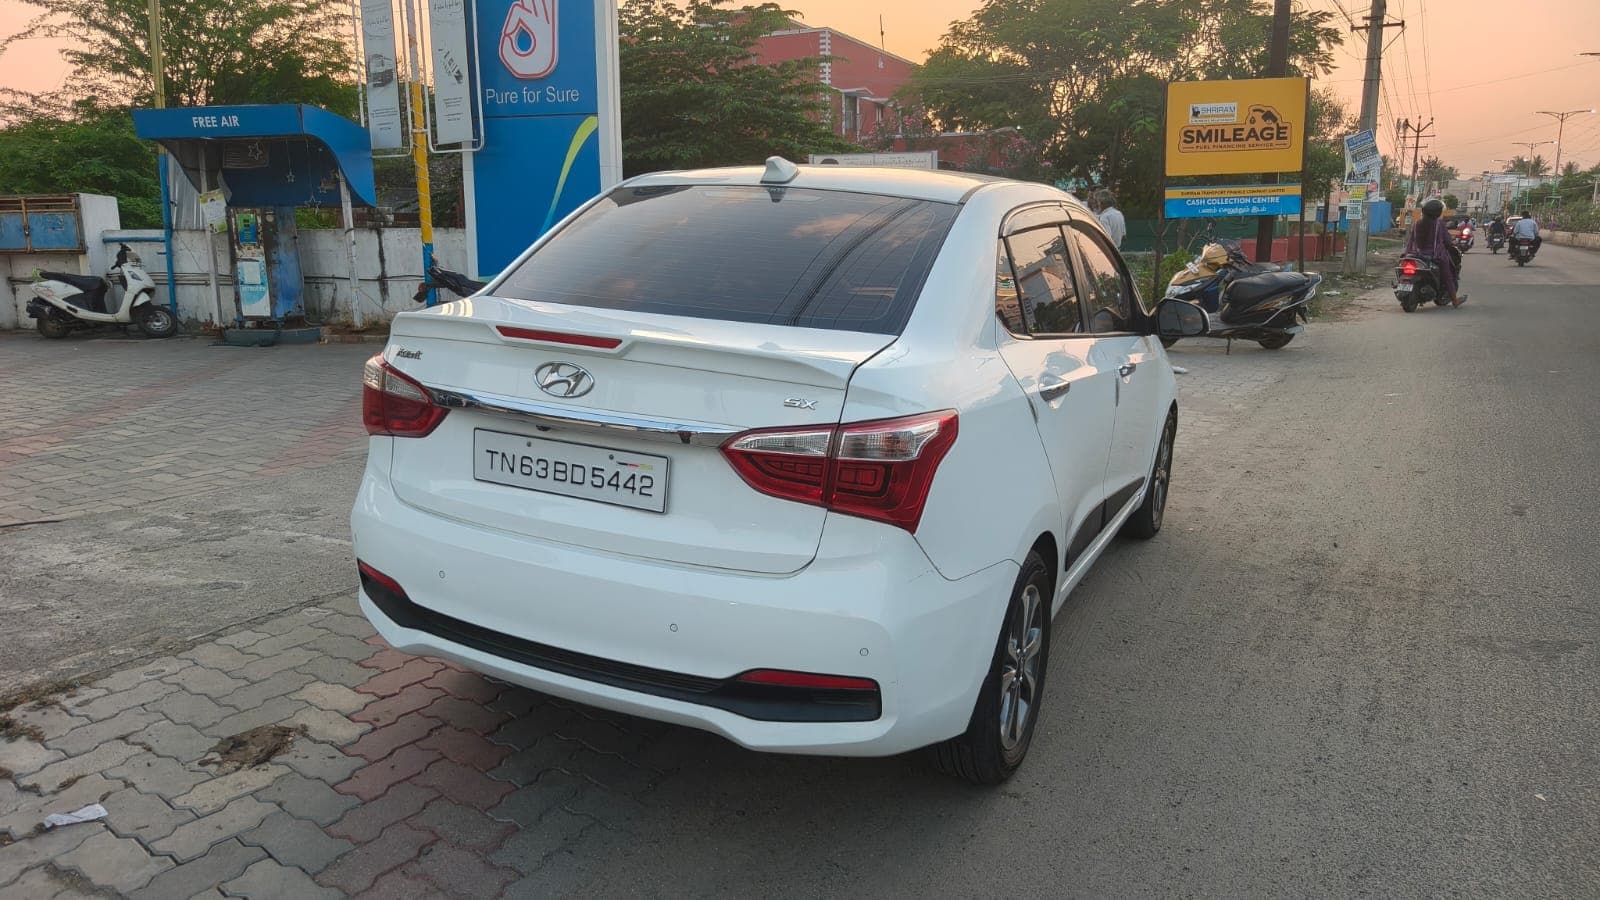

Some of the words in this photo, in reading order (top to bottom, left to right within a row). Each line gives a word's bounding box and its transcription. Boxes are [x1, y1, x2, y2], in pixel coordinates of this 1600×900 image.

[485, 88, 519, 104] Pure
[522, 87, 541, 103] for
[545, 86, 580, 103] Sure
[1200, 105, 1236, 114] SHRIRAM
[192, 116, 218, 128] FREE
[221, 115, 240, 127] AIR
[1183, 124, 1288, 145] SMILEAGE
[1185, 198, 1206, 206] CASH
[1206, 197, 1251, 206] COLLECTION
[1252, 196, 1281, 204] CENTRE
[784, 398, 817, 411] SX
[486, 449, 653, 497] TN63BD5442
